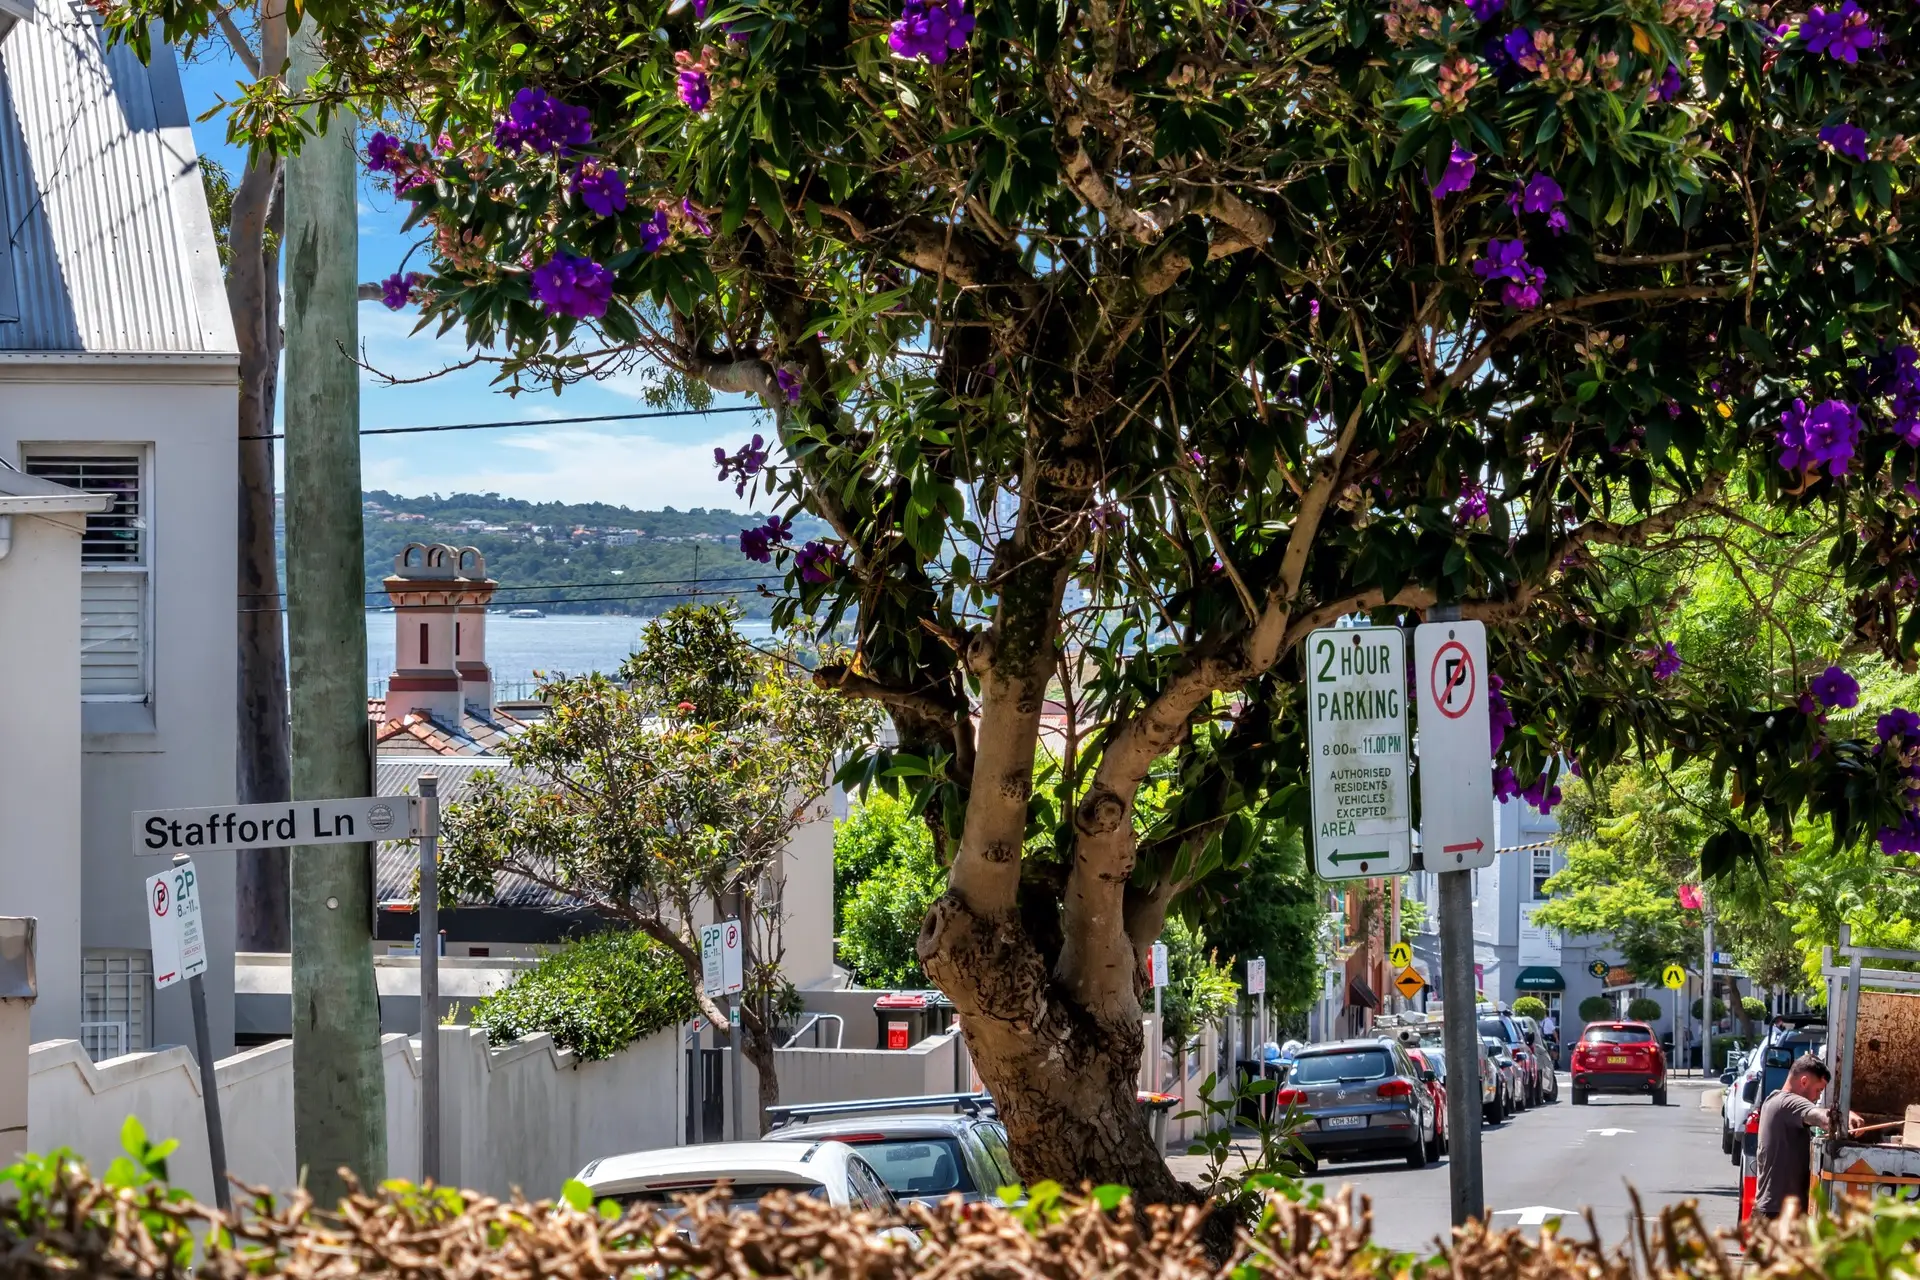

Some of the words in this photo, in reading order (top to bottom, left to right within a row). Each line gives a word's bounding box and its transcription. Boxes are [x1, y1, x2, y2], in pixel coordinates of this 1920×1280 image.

[1316, 638, 1337, 683] 2
[1341, 645, 1390, 676] HOUR
[1318, 688, 1398, 722] PARKING
[1330, 767, 1391, 780] AUTHORISED
[1334, 780, 1388, 793] RESIDENTS
[1337, 793, 1385, 806] VEHICLES
[1336, 806, 1387, 819] EXCEPTED
[145, 808, 296, 849] Stafford
[313, 807, 354, 838] Ln
[1321, 820, 1356, 837] AREA
[175, 870, 194, 902] 2P
[703, 928, 720, 948] 2P
[731, 1009, 740, 1023] H
